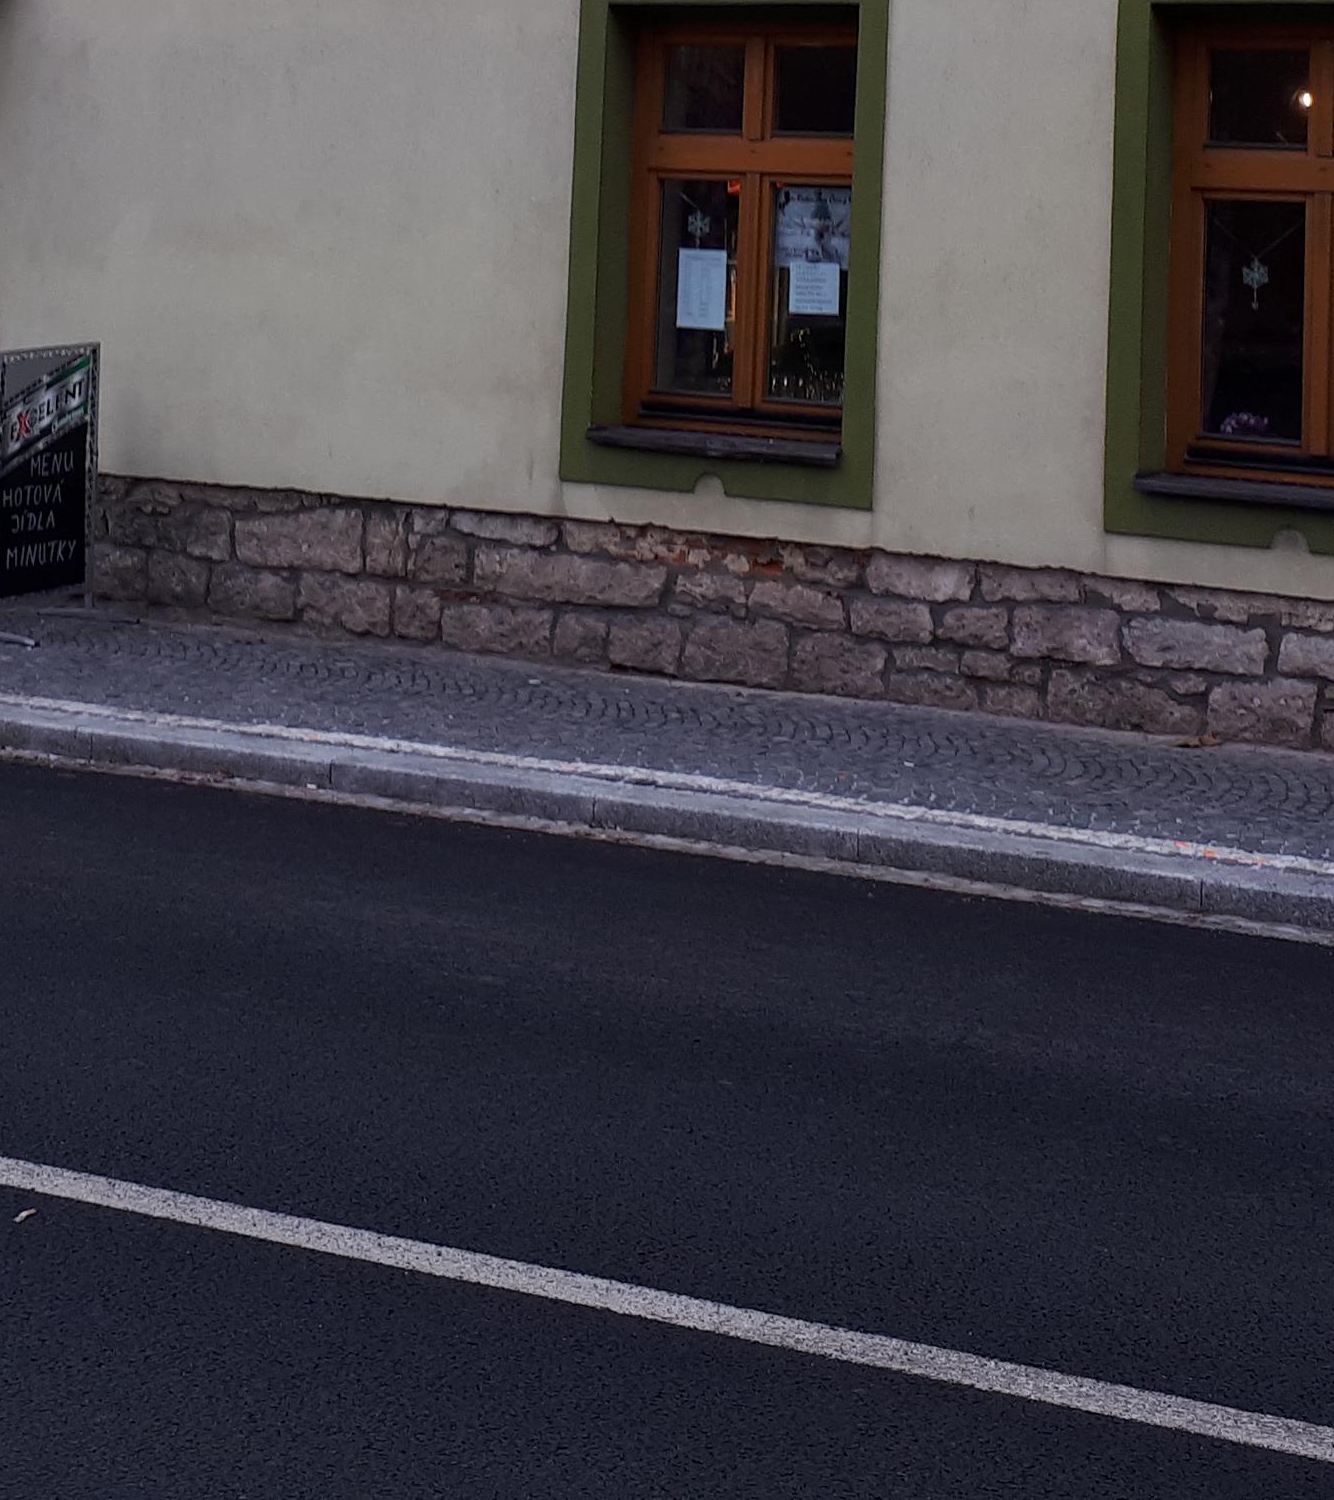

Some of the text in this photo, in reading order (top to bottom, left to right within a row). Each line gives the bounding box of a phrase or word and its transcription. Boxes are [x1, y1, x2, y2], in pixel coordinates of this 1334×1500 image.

[10, 379, 84, 441] EXCELENT
[30, 452, 74, 477] MENU
[2, 479, 64, 508] HOTOVÁ
[11, 511, 55, 534] JÍDLA
[5, 539, 76, 570] MINUTKY
